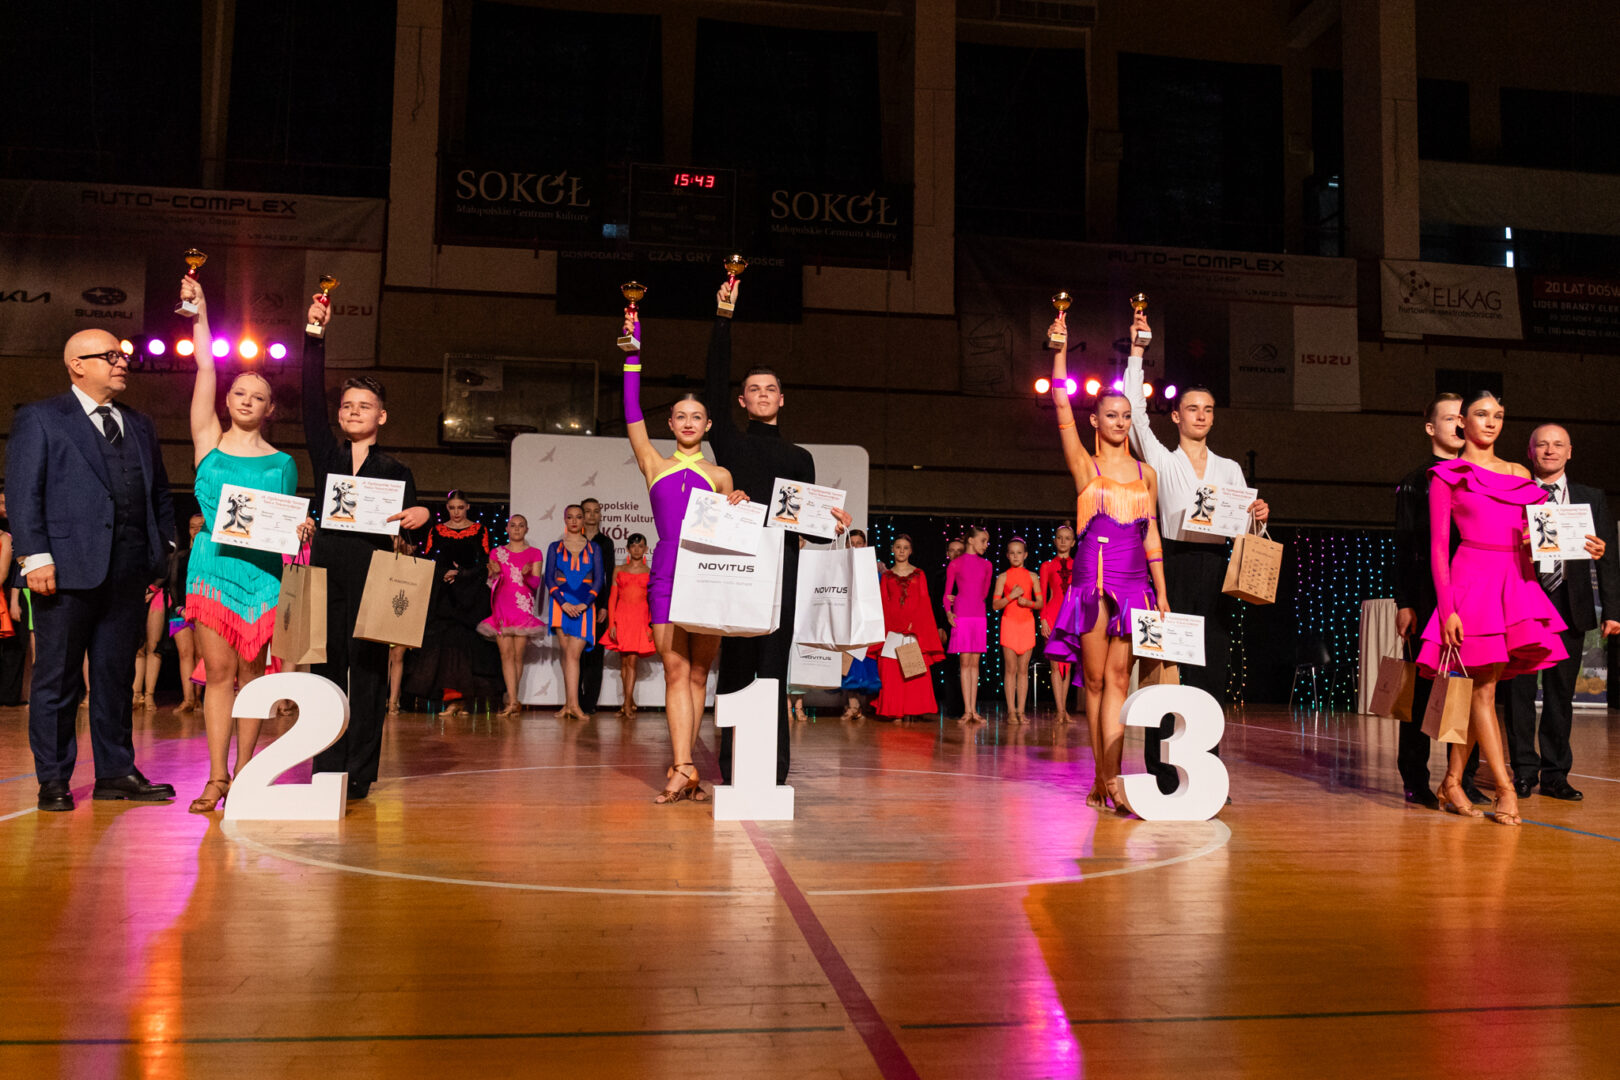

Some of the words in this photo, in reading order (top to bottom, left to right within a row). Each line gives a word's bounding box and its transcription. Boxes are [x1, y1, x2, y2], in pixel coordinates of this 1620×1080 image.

[674, 173, 715, 188] 15:43
[81, 190, 297, 214] AUTO-COMPLEX
[648, 250, 682, 262] CZAS
[686, 251, 712, 263] GRY
[1108, 251, 1285, 273] AUTO-COMPLEX
[1545, 281, 1560, 294] 20
[1563, 282, 1585, 295] LAT
[75, 309, 133, 319] SUBARU
[332, 305, 373, 316] UZU
[1301, 353, 1351, 366] ISUZU
[624, 514, 656, 523] Kultur
[602, 525, 630, 540] KÓŁ
[698, 562, 755, 573] NOVITUS
[814, 586, 848, 594] NOVITUS
[225, 672, 350, 820] 2
[713, 678, 795, 820] 1
[1118, 684, 1229, 821] 3
